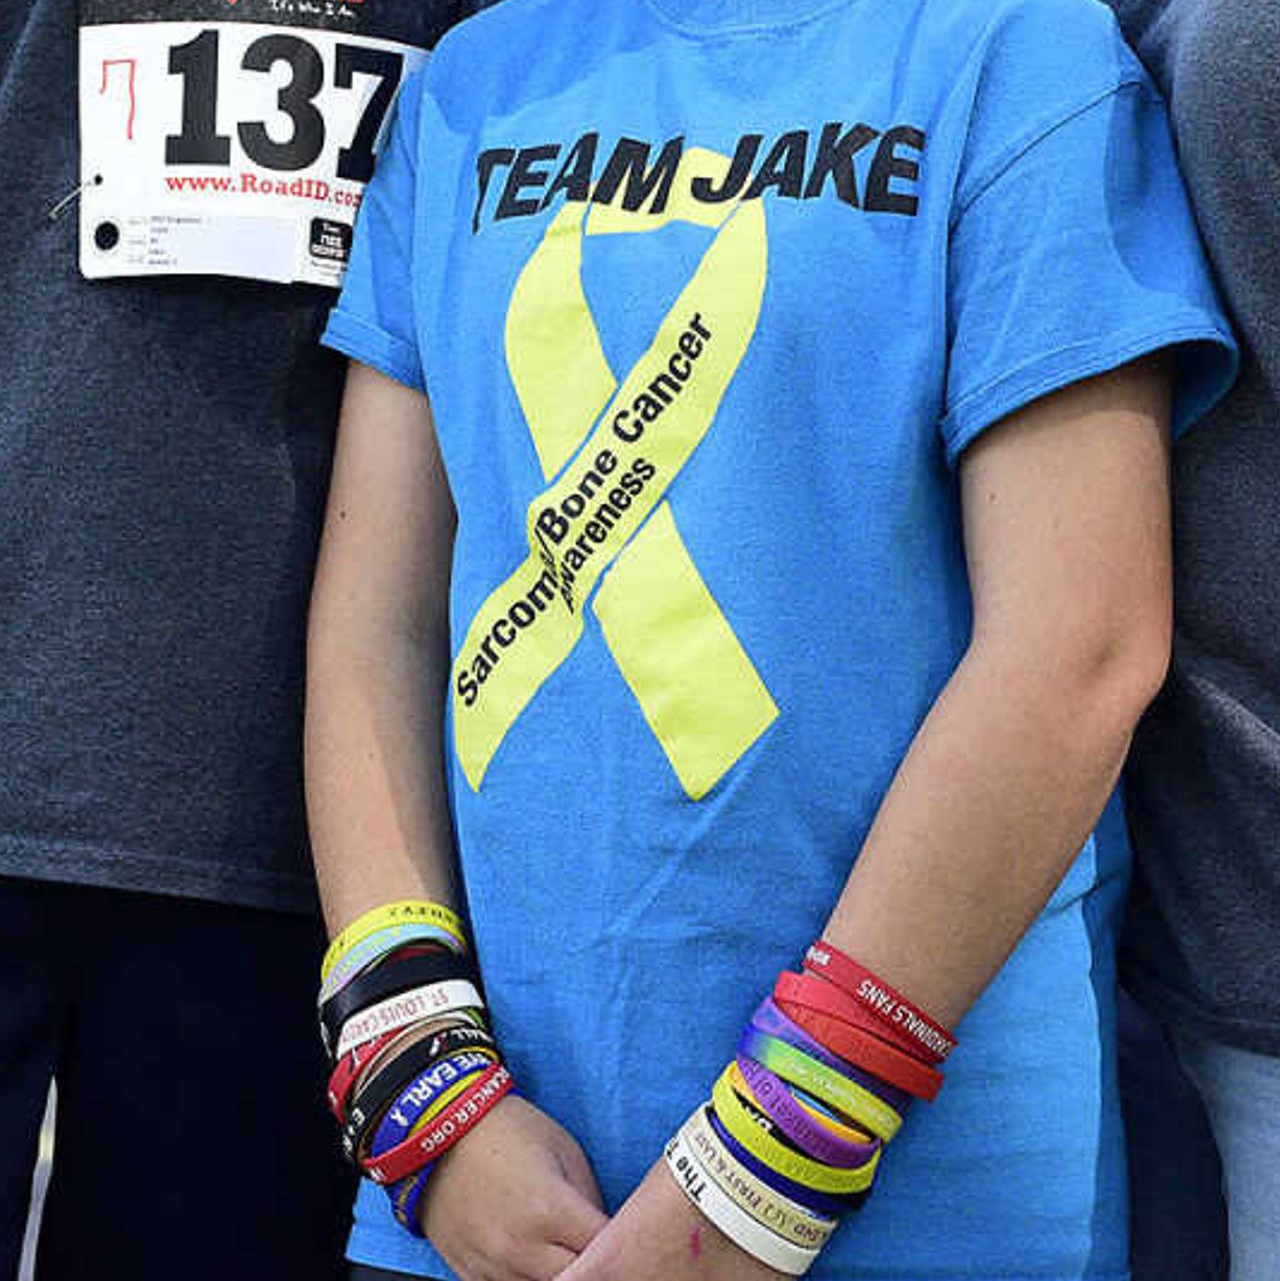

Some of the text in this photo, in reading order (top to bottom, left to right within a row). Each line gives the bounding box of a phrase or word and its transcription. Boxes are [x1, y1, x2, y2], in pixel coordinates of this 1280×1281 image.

[165, 29, 404, 184] 137
[472, 122, 926, 236] TEAM JAKE
[612, 311, 713, 445] Cancer
[855, 978, 898, 1016] FANS
[675, 1155, 708, 1205] The
